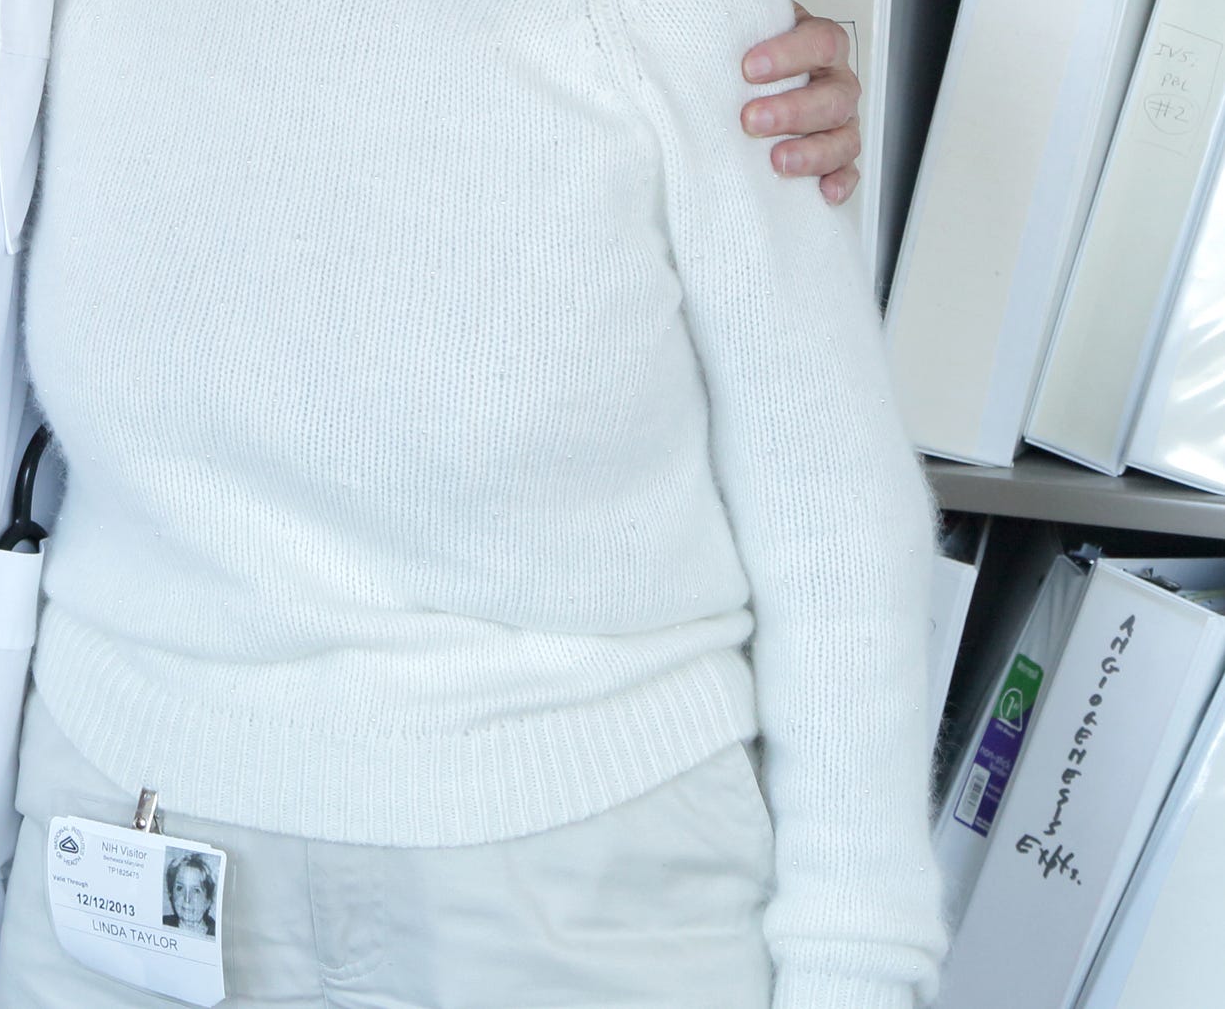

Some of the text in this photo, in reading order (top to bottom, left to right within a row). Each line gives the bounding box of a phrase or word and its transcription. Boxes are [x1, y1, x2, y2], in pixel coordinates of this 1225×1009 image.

[1043, 614, 1136, 837] ANGIOGENESIS
[101, 841, 148, 860] NIH Visitor
[65, 878, 89, 888] Through
[76, 892, 136, 916] 12/12/2013
[92, 919, 179, 951] LINDA TAYLOR
